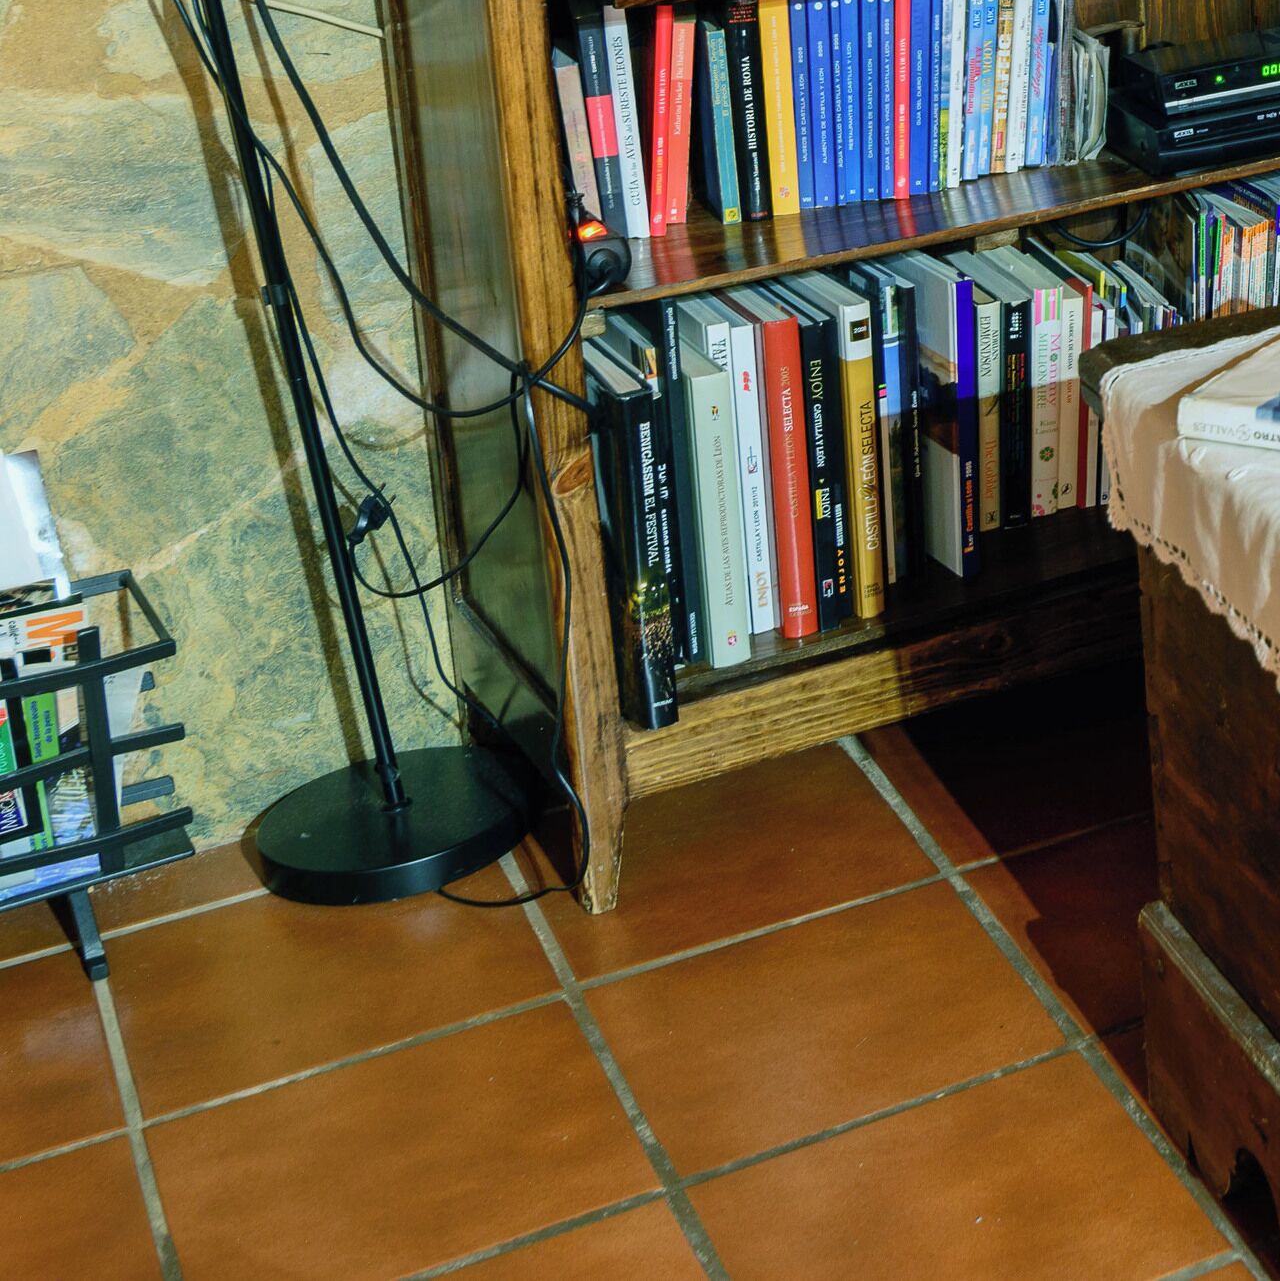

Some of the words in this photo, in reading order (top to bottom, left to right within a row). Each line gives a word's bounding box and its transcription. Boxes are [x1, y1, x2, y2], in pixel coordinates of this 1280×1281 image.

[973, 10, 982, 29] ABC
[987, 6, 995, 26] ABC
[612, 36, 627, 77] LEONÉS
[741, 55, 752, 86] ROMA
[744, 87, 754, 101] DE
[996, 35, 1011, 125] TRAFFIC
[616, 79, 632, 123] SURESTE
[799, 98, 807, 125] CASTILLA
[819, 91, 827, 119] CASTILLA
[746, 103, 758, 150] HISTORIA
[626, 135, 637, 161] AVES
[629, 180, 641, 206] GUÍA
[979, 315, 993, 378] EDMONDSON
[992, 329, 1000, 361] ADRIAN
[809, 359, 824, 400] ENJOY
[1037, 332, 1049, 409] MILLIONAIRE
[781, 388, 794, 432] SELECTA
[813, 403, 824, 438] CASTILLA
[859, 401, 875, 454] SELECTA
[1193, 421, 1236, 437] VALLES
[639, 421, 656, 497] BENICÀSSIM
[816, 446, 826, 468] LEÓN
[985, 437, 997, 459] The
[984, 460, 997, 501] Gobbler
[644, 497, 656, 513] EL
[717, 469, 729, 536] REPRODUCTORAS
[820, 487, 831, 519] ENJOY
[646, 513, 660, 567] FESTIVAL
[722, 537, 730, 555] AVES
[753, 533, 762, 562] CASTILLA
[837, 549, 846, 594] ENJOY
[724, 582, 734, 606] ATLAS
[755, 570, 769, 607] ENJOY
